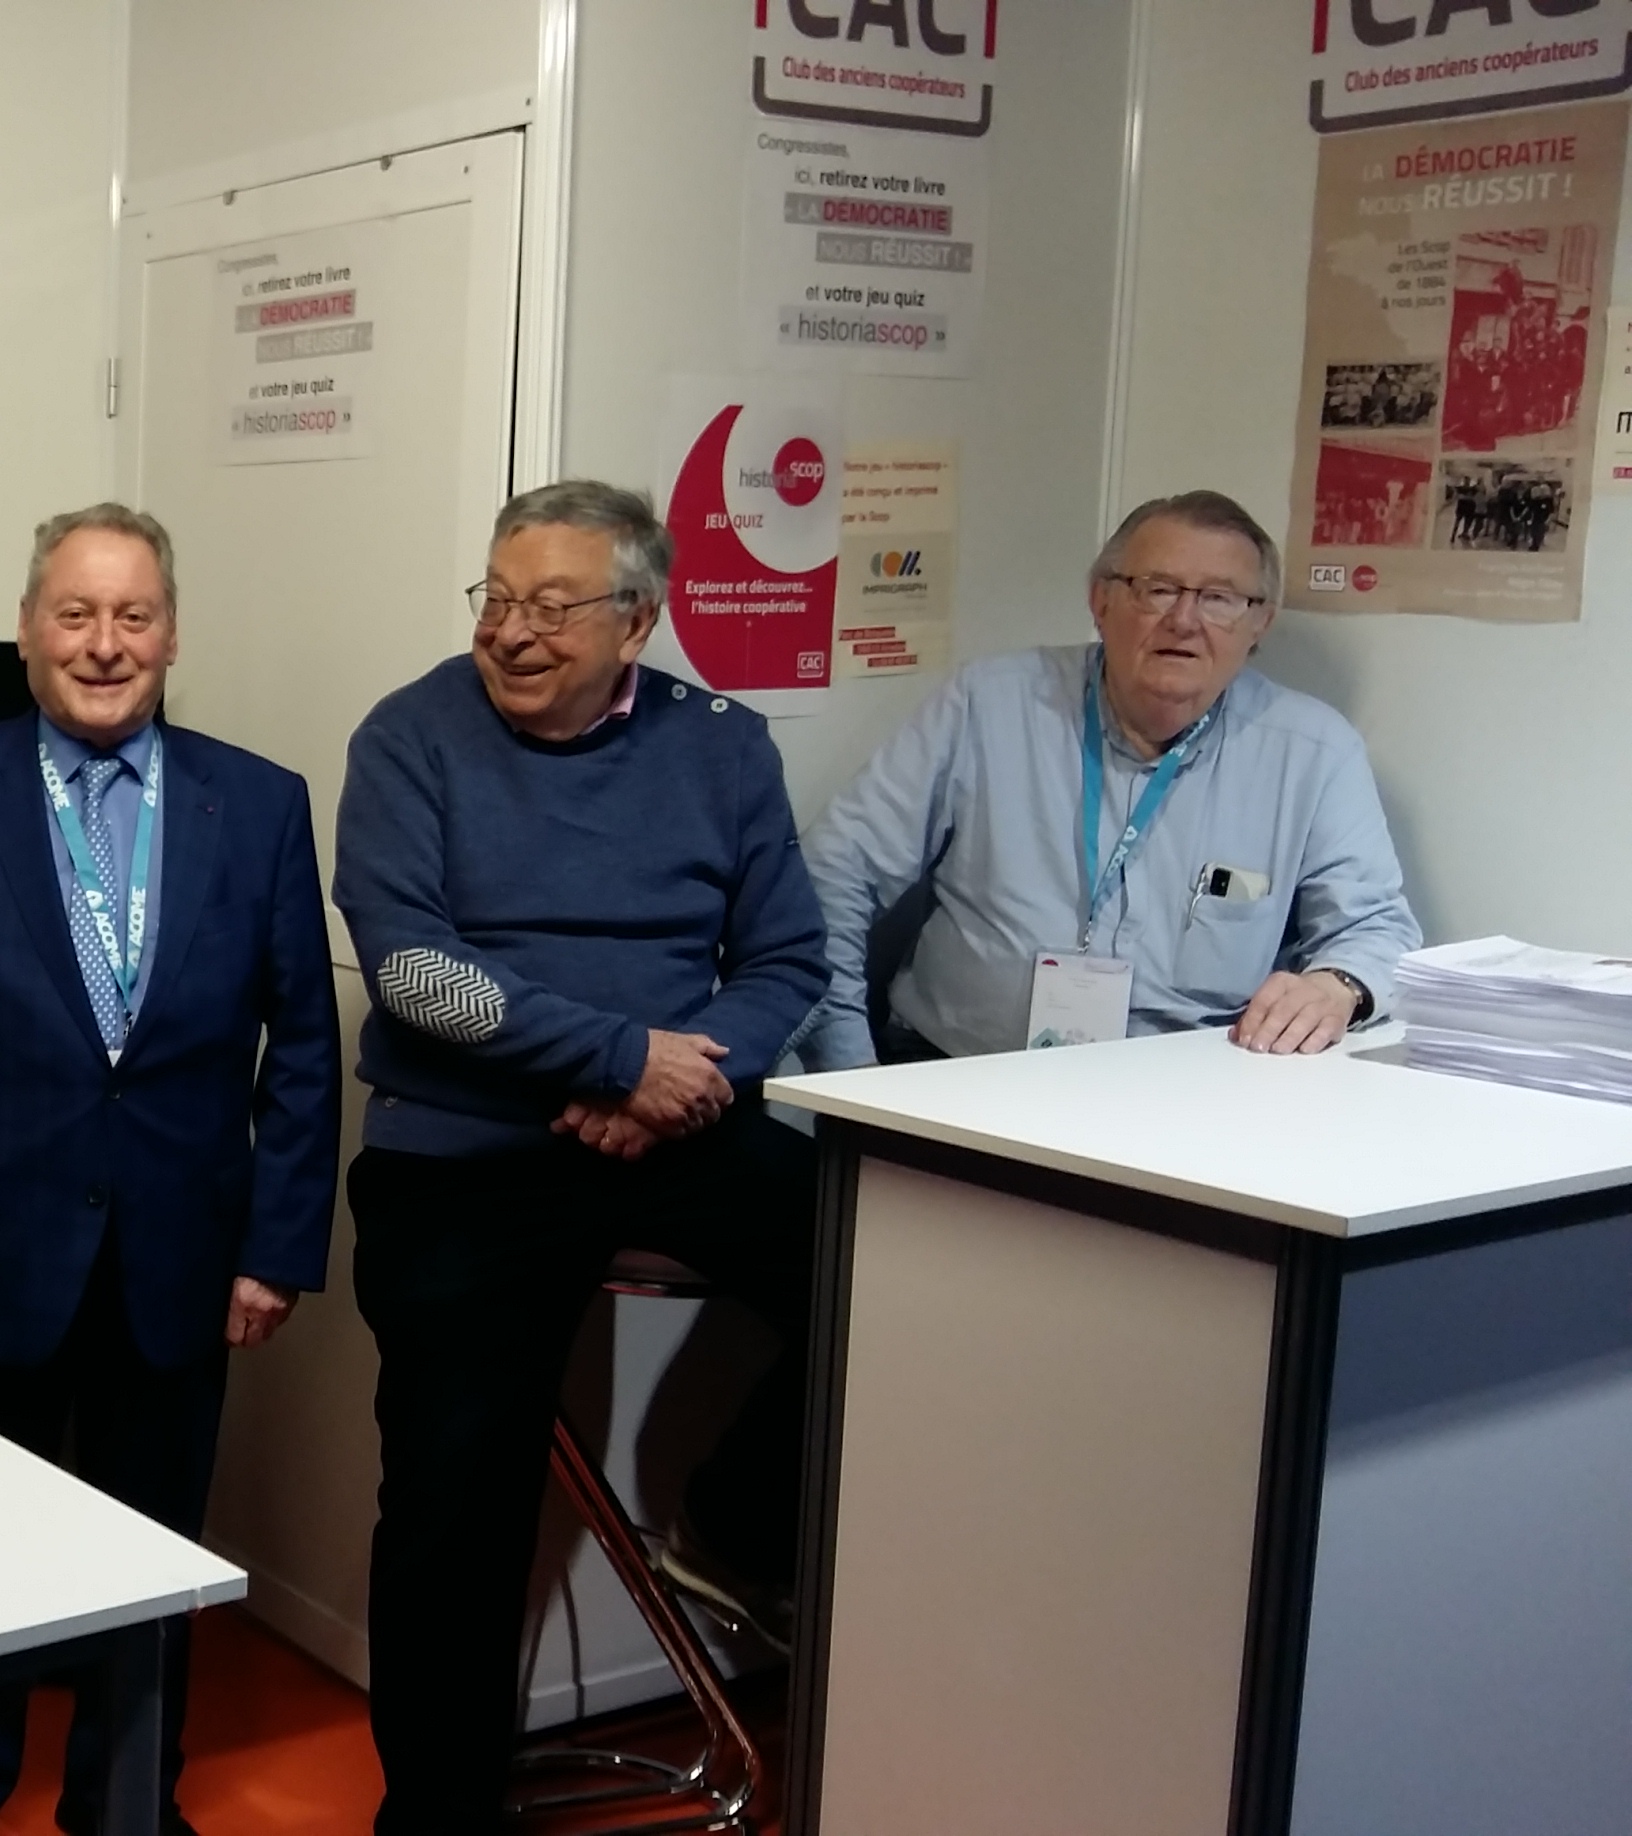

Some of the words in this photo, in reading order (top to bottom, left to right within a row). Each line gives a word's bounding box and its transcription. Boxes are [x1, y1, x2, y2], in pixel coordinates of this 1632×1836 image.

[782, 56, 811, 79] Club
[814, 60, 836, 82] des
[839, 65, 886, 89] anciens
[889, 70, 966, 99] coopérateurs
[1344, 67, 1379, 93] Club
[1383, 65, 1411, 88] des
[1415, 55, 1478, 82] anciens
[1483, 38, 1599, 72] coopérateurs
[1395, 136, 1577, 179] DÉMOCRATIE
[820, 169, 868, 189] retirez
[872, 175, 910, 193] votre
[914, 175, 946, 196] livre
[1422, 171, 1557, 211] RÉUSSIT
[1562, 173, 1573, 198] !
[823, 197, 949, 231] DÉMOCRATIE
[294, 271, 323, 289] votre
[824, 286, 862, 303] votre
[866, 287, 889, 307] jeu
[894, 290, 925, 308] quiz
[798, 313, 928, 350] historiascop
[261, 381, 288, 397] votre
[291, 379, 307, 399] jeu
[310, 376, 334, 396] quiz
[243, 408, 336, 434] historiascop
[789, 461, 824, 482] scop
[704, 513, 728, 529] JEU
[733, 513, 764, 529] QUIZ
[685, 580, 733, 595] Explorez
[736, 580, 747, 594] et
[691, 601, 740, 616] l'histoire
[743, 600, 806, 616] coopérative
[800, 656, 821, 670] CAC
[40, 758, 70, 812] ACOME
[129, 887, 146, 946] ACOME
[93, 911, 123, 969] ACOME
